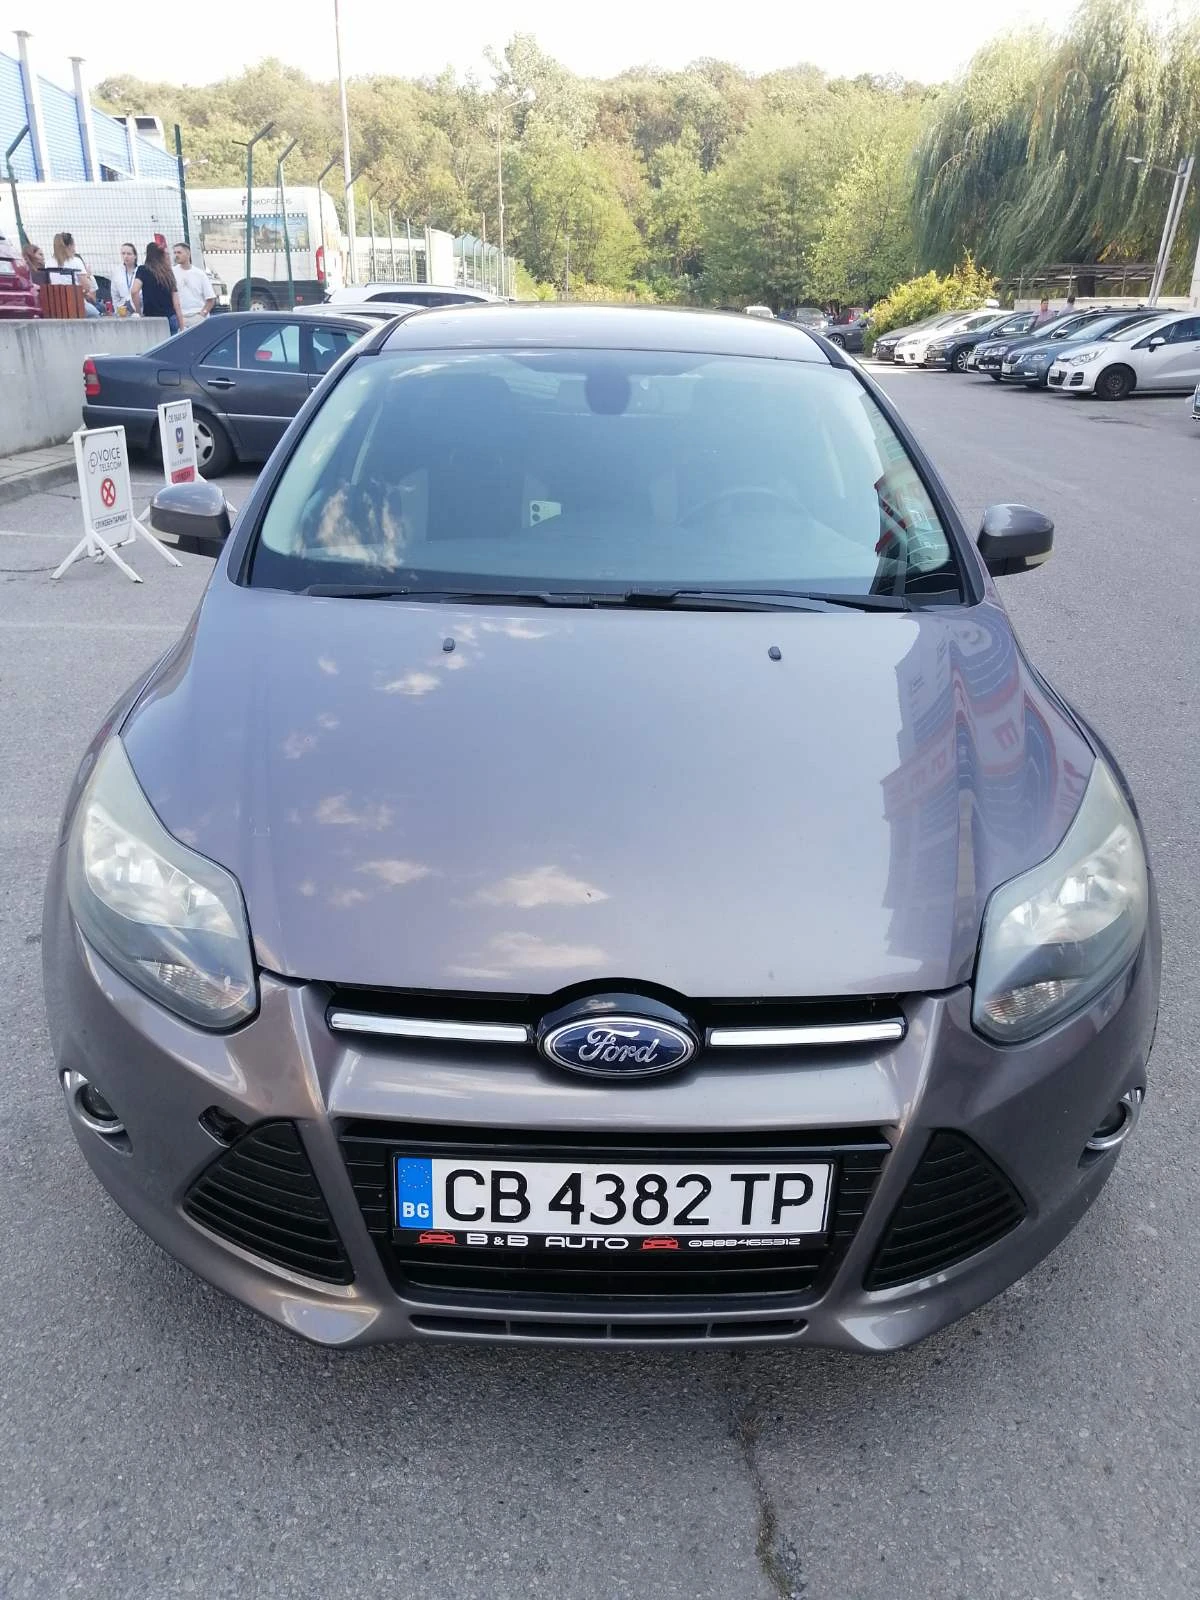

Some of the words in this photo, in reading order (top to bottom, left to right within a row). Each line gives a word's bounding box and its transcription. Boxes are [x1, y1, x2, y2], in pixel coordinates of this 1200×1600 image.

[97, 447, 121, 462] VOICE
[99, 461, 122, 472] TELECOM
[578, 1028, 660, 1063] Ford
[445, 1168, 531, 1223] CB
[548, 1172, 712, 1226] 4382
[730, 1172, 814, 1226] TP
[402, 1202, 430, 1218] BG
[545, 1235, 629, 1250] AUTO
